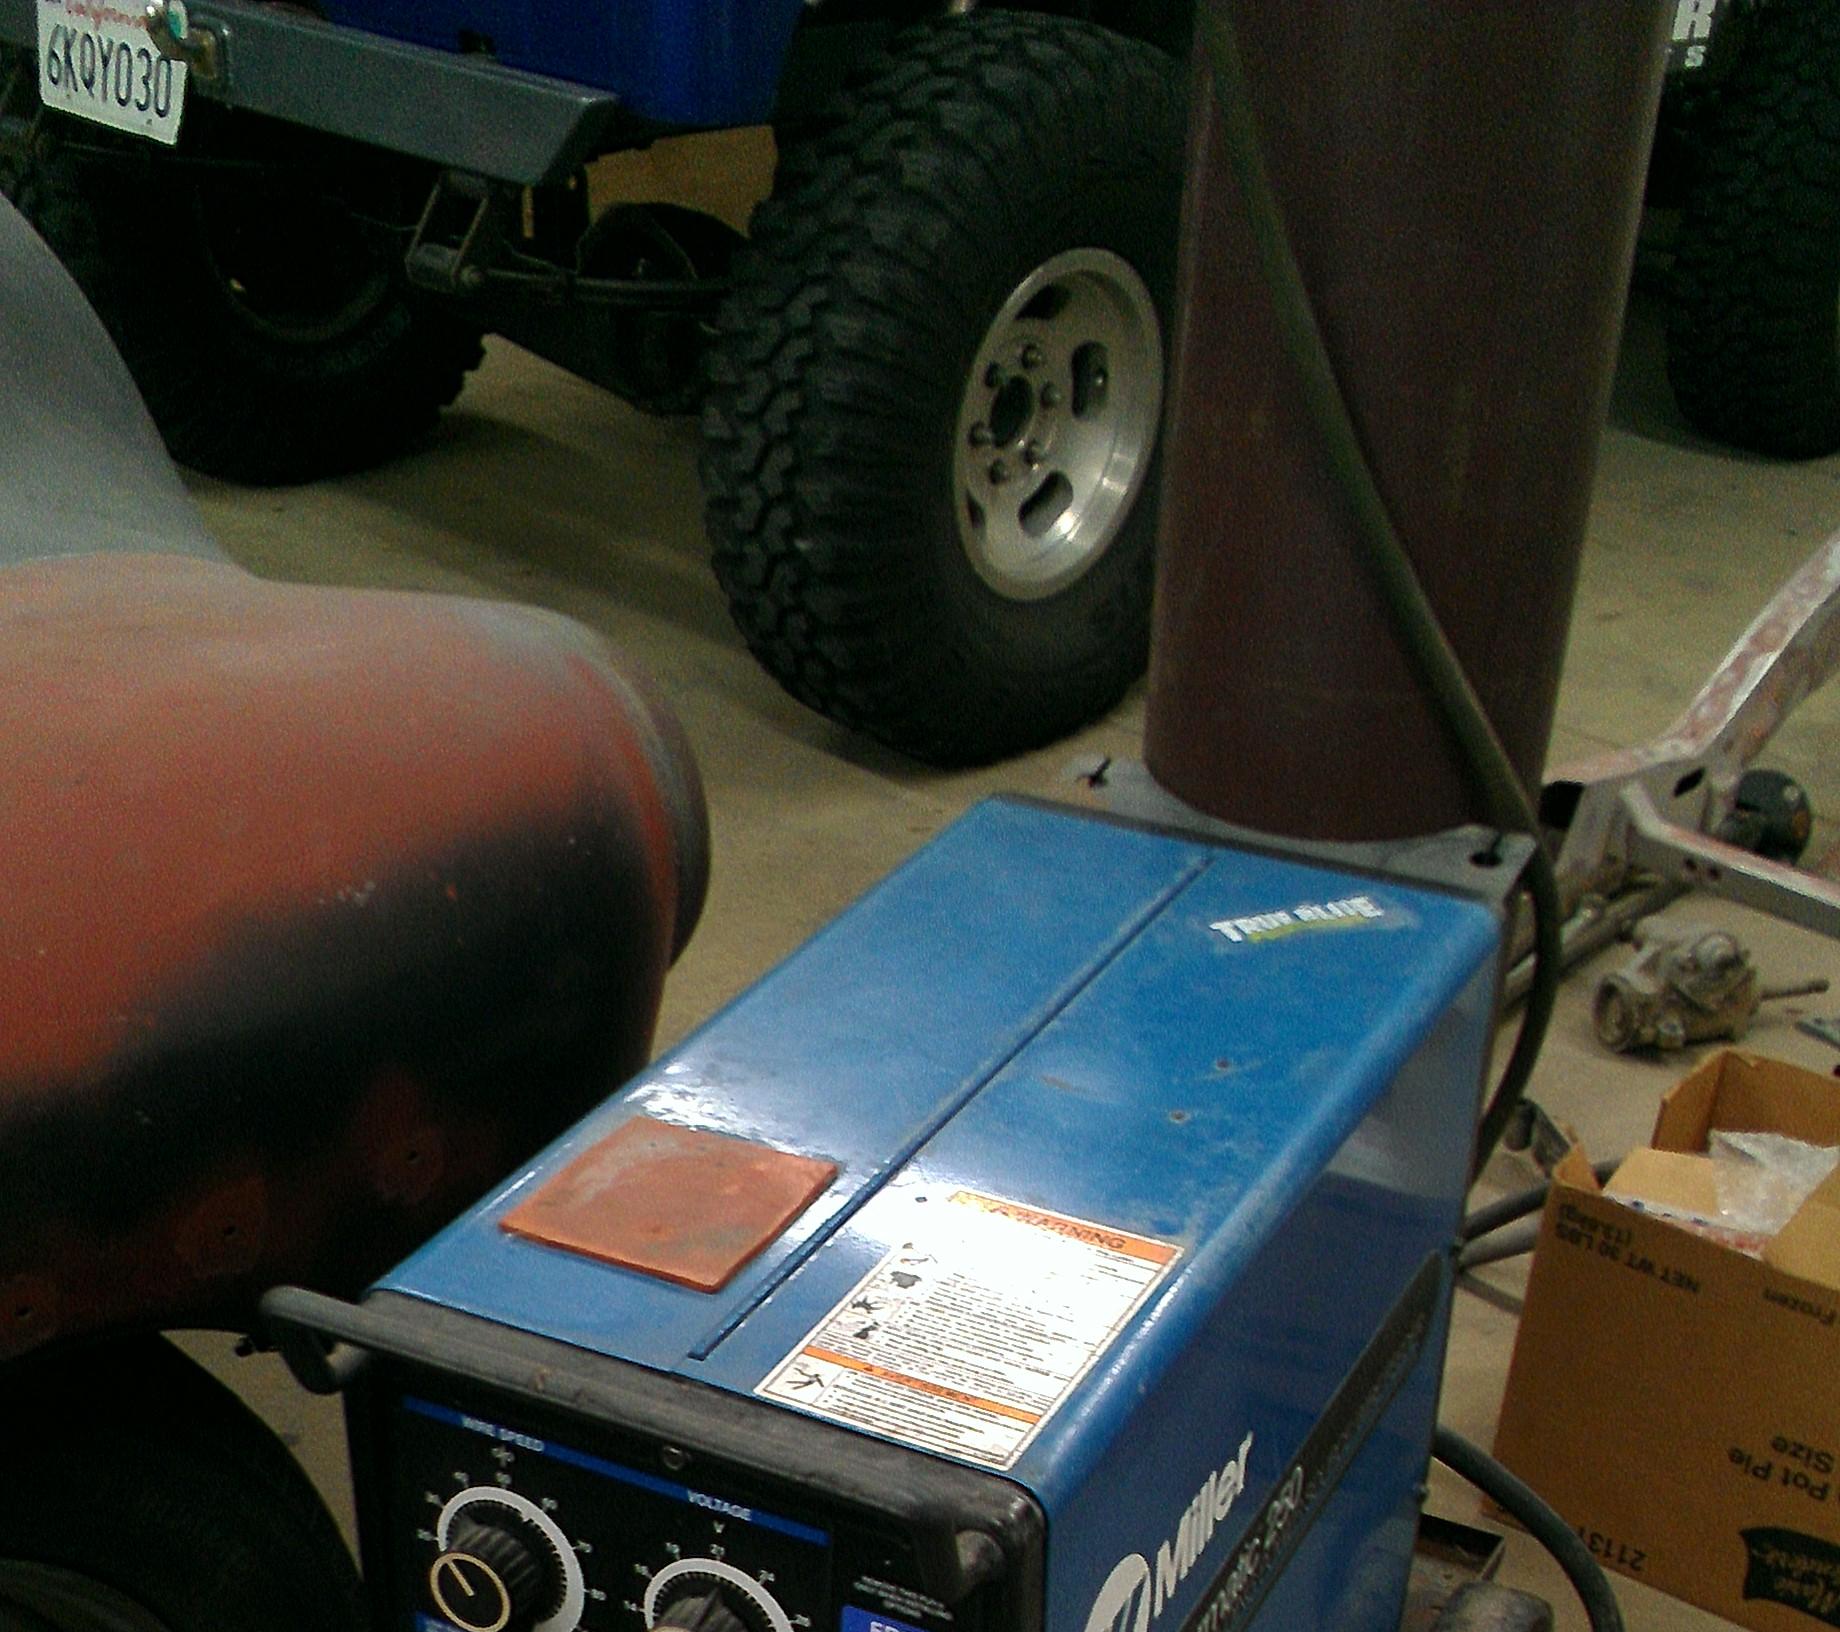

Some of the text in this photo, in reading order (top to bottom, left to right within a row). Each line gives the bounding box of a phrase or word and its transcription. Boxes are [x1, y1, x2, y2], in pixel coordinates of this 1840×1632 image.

[1728, 1446, 1830, 1502] Pot Pie
[1770, 1435, 1835, 1474] Size
[687, 1489, 752, 1521] VOLTAGE
[1154, 1431, 1253, 1618] Miller
